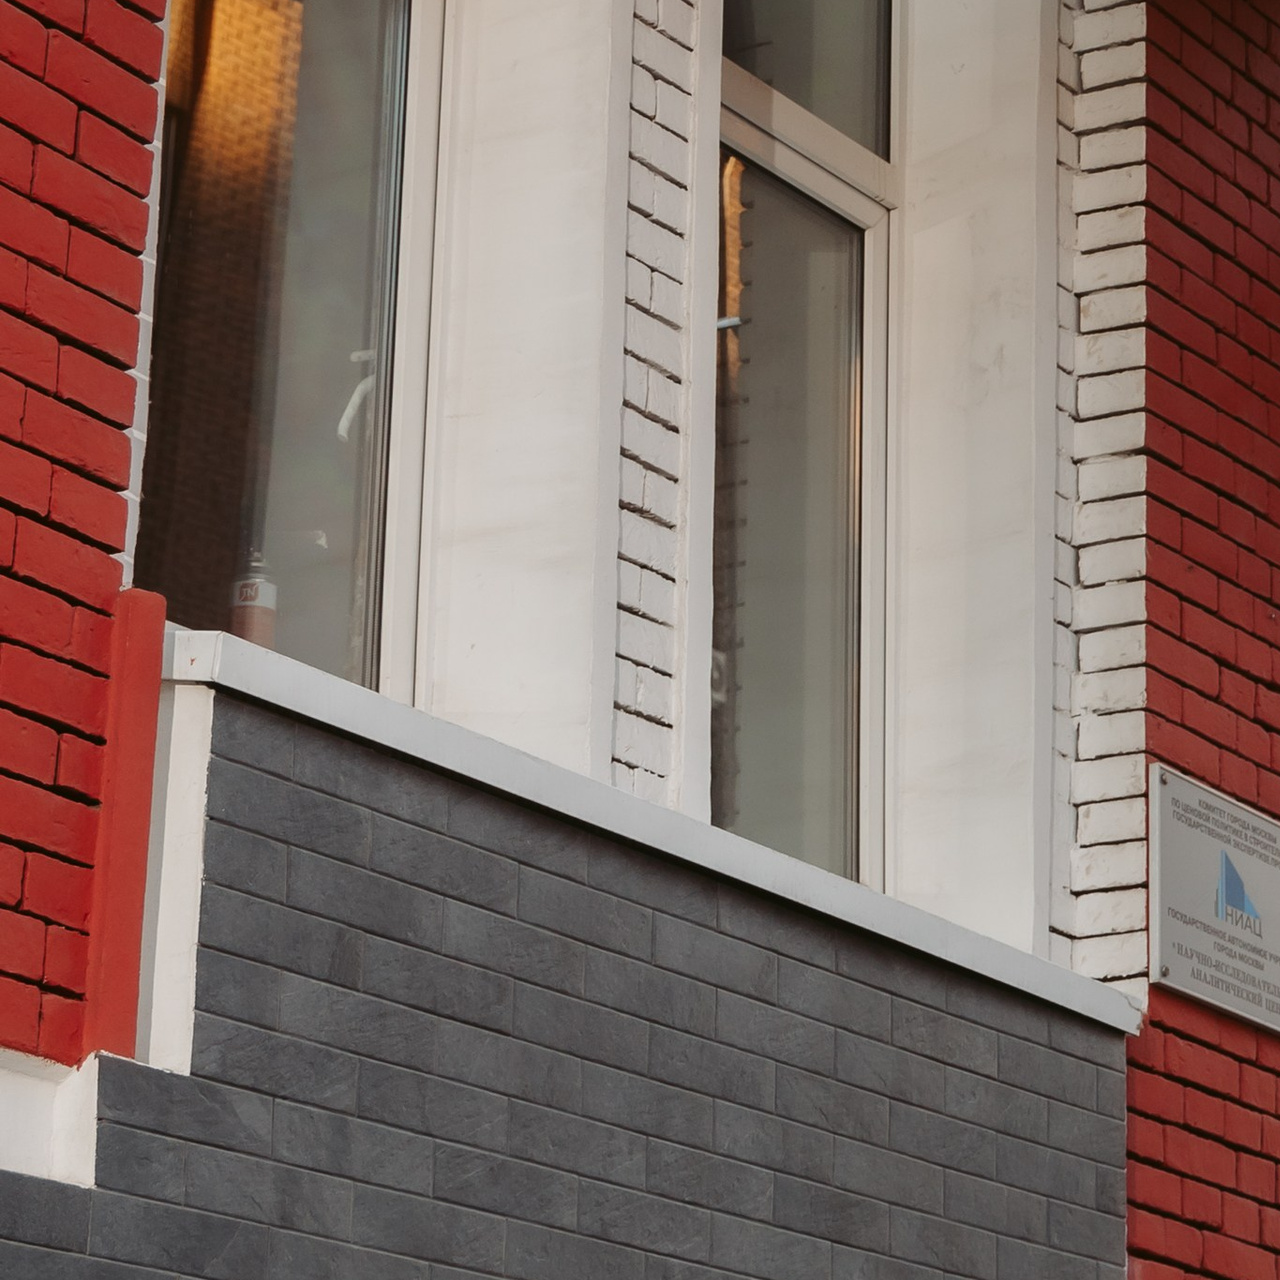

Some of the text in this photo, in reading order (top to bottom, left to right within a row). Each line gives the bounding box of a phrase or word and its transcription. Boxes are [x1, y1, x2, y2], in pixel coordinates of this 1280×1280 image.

[1171, 797, 1180, 809] ПО
[1181, 802, 1210, 824] ЦЕНОВОЙ
[1211, 817, 1243, 839] ПОЛИТИКЕ
[1172, 809, 1231, 845] ГОСУДАРСТВЕННОЙ
[1198, 799, 1276, 843] КОМИТЕТ ГОРОДА МОСКВЫ
[1167, 907, 1225, 940] ГОСУДАРСТВЕННОЕ
[1227, 934, 1267, 958] АВТОНОМНОЕ
[1225, 905, 1262, 938] НИАЦ
[1213, 941, 1264, 970] ГОРОДА МОСКВЫ
[1190, 965, 1262, 1006] АНАЛИТИЧЕСКИЙ
